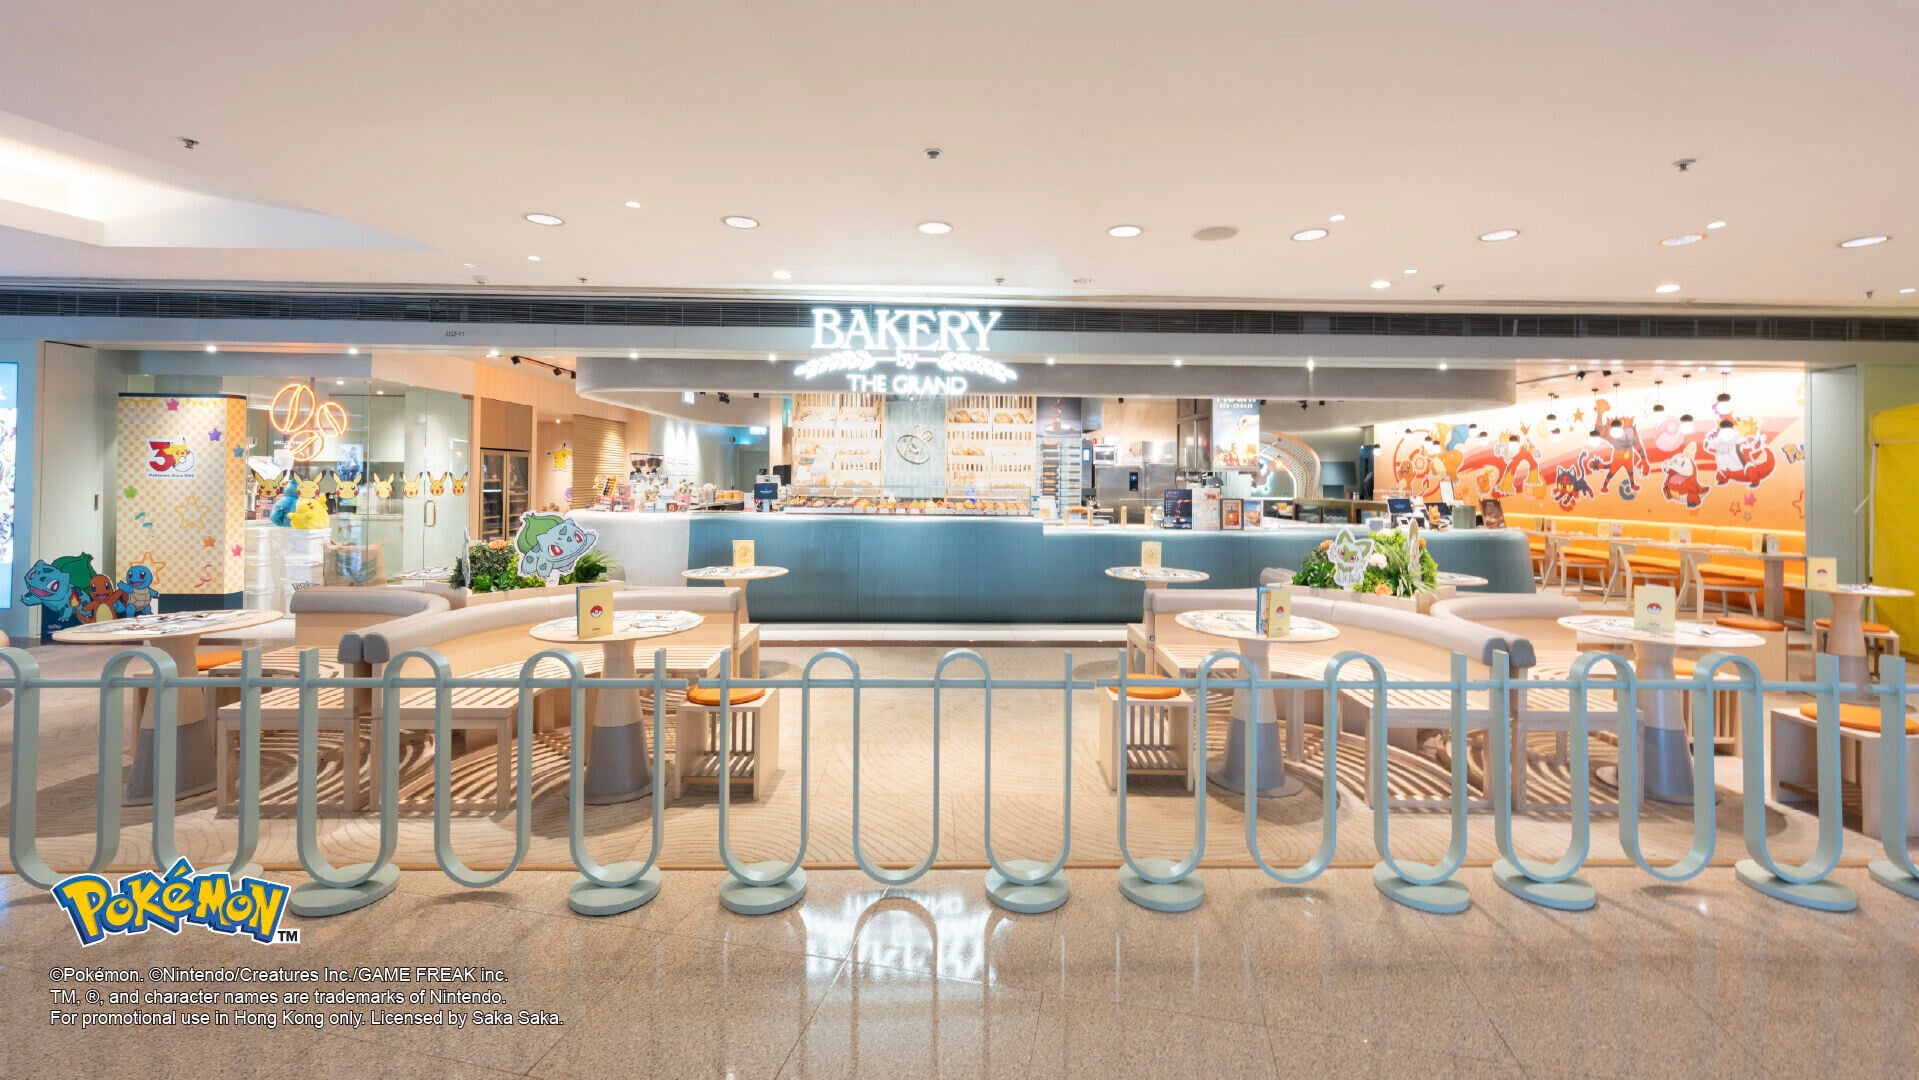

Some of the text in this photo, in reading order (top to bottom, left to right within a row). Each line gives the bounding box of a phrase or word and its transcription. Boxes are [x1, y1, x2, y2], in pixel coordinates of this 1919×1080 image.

[811, 308, 1002, 351] BAKERY
[895, 347, 919, 369] by
[847, 374, 967, 394] THE GRAND
